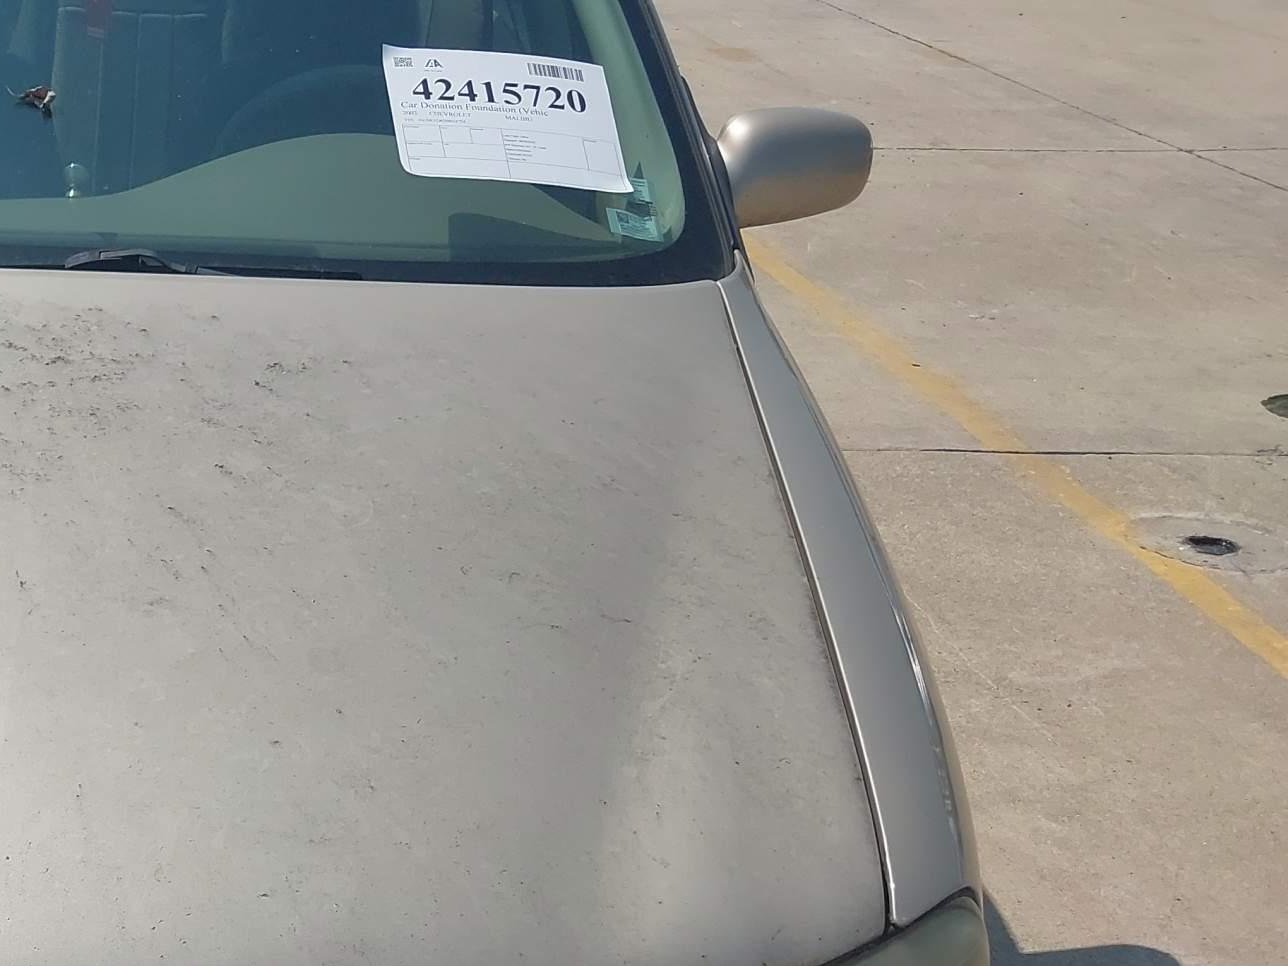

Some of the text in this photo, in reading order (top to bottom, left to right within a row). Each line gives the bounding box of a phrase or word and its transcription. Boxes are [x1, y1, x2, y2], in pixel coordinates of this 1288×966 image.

[400, 101, 418, 109] Car
[421, 102, 463, 110] Donation
[465, 103, 516, 113] Foundation
[412, 78, 587, 113] 42415720
